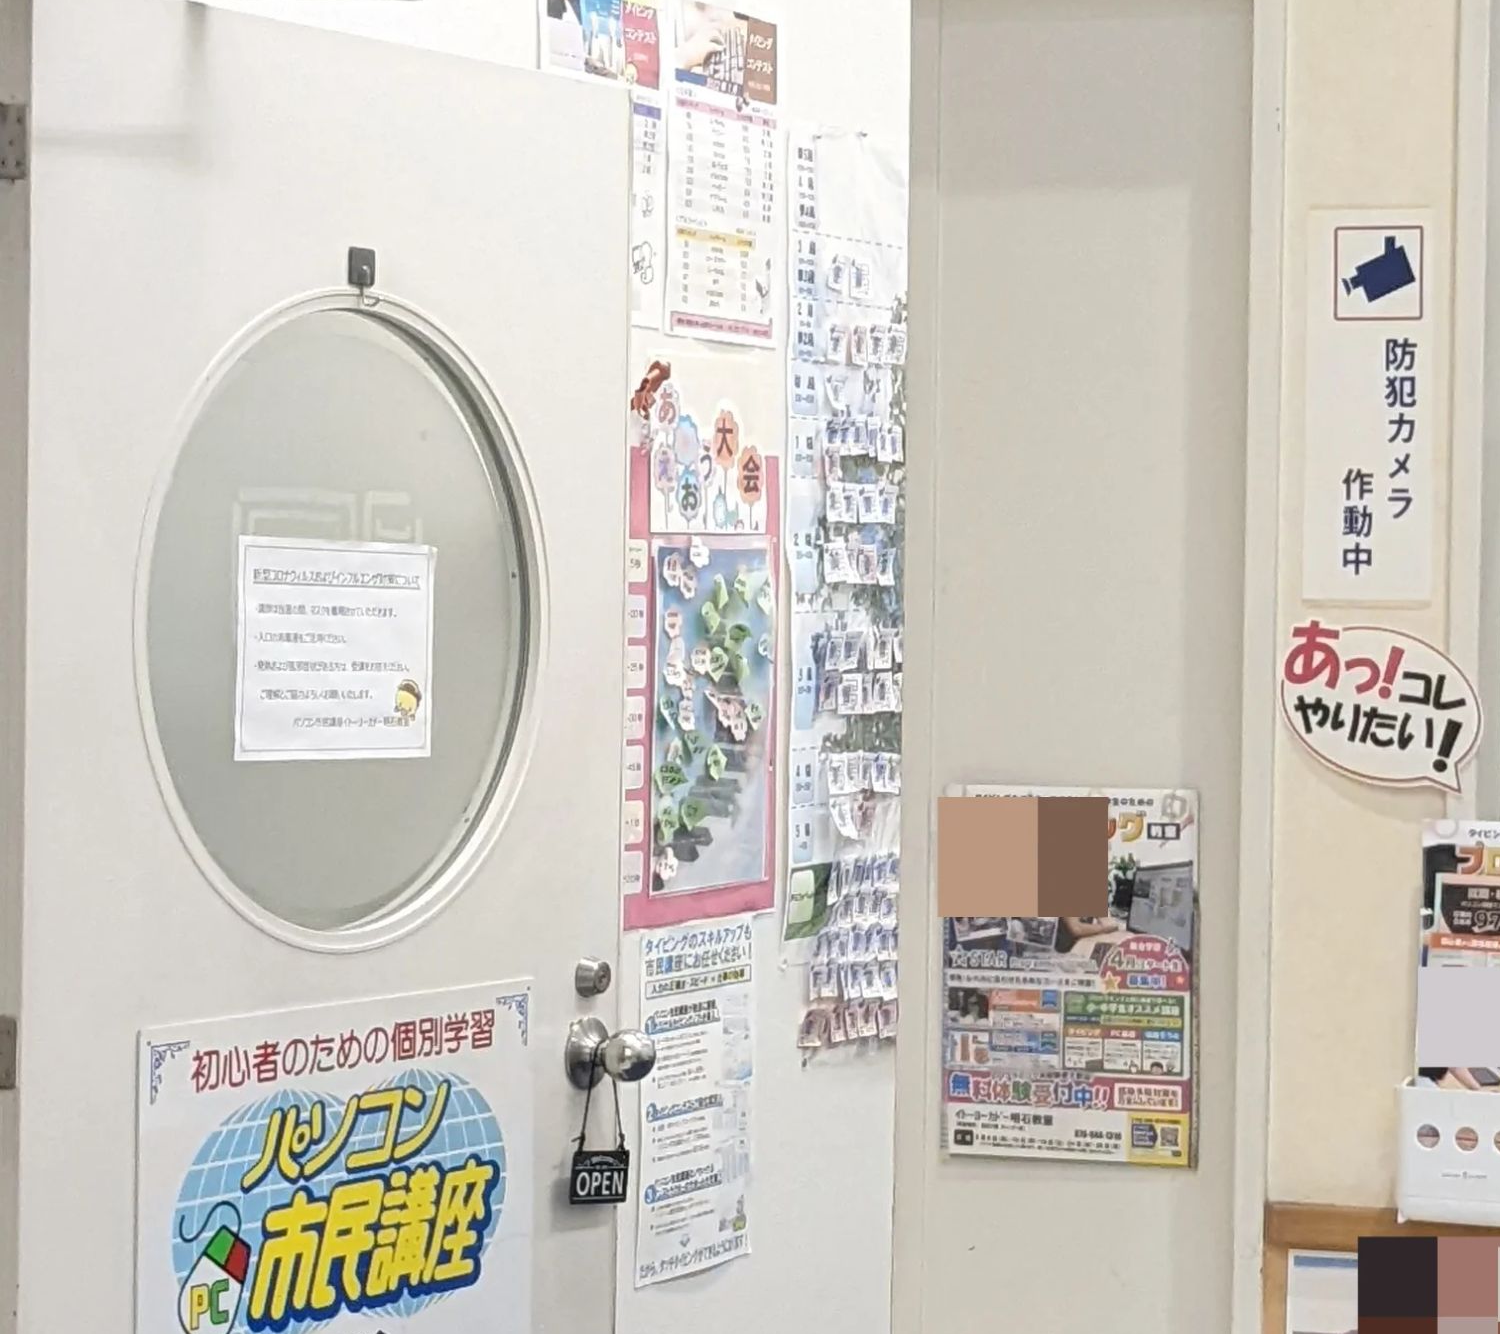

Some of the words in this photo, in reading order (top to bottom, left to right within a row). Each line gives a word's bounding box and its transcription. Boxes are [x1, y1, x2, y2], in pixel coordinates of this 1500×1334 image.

[1385, 338, 1418, 520] 防犯カメラ
[1342, 468, 1375, 576] 作動中
[191, 1009, 496, 1093] 初心者のための個別学習
[241, 1080, 450, 1192] パソコン
[575, 1171, 625, 1197] OPEN
[249, 1159, 496, 1324] 市民講座
[190, 1278, 230, 1330] PC
